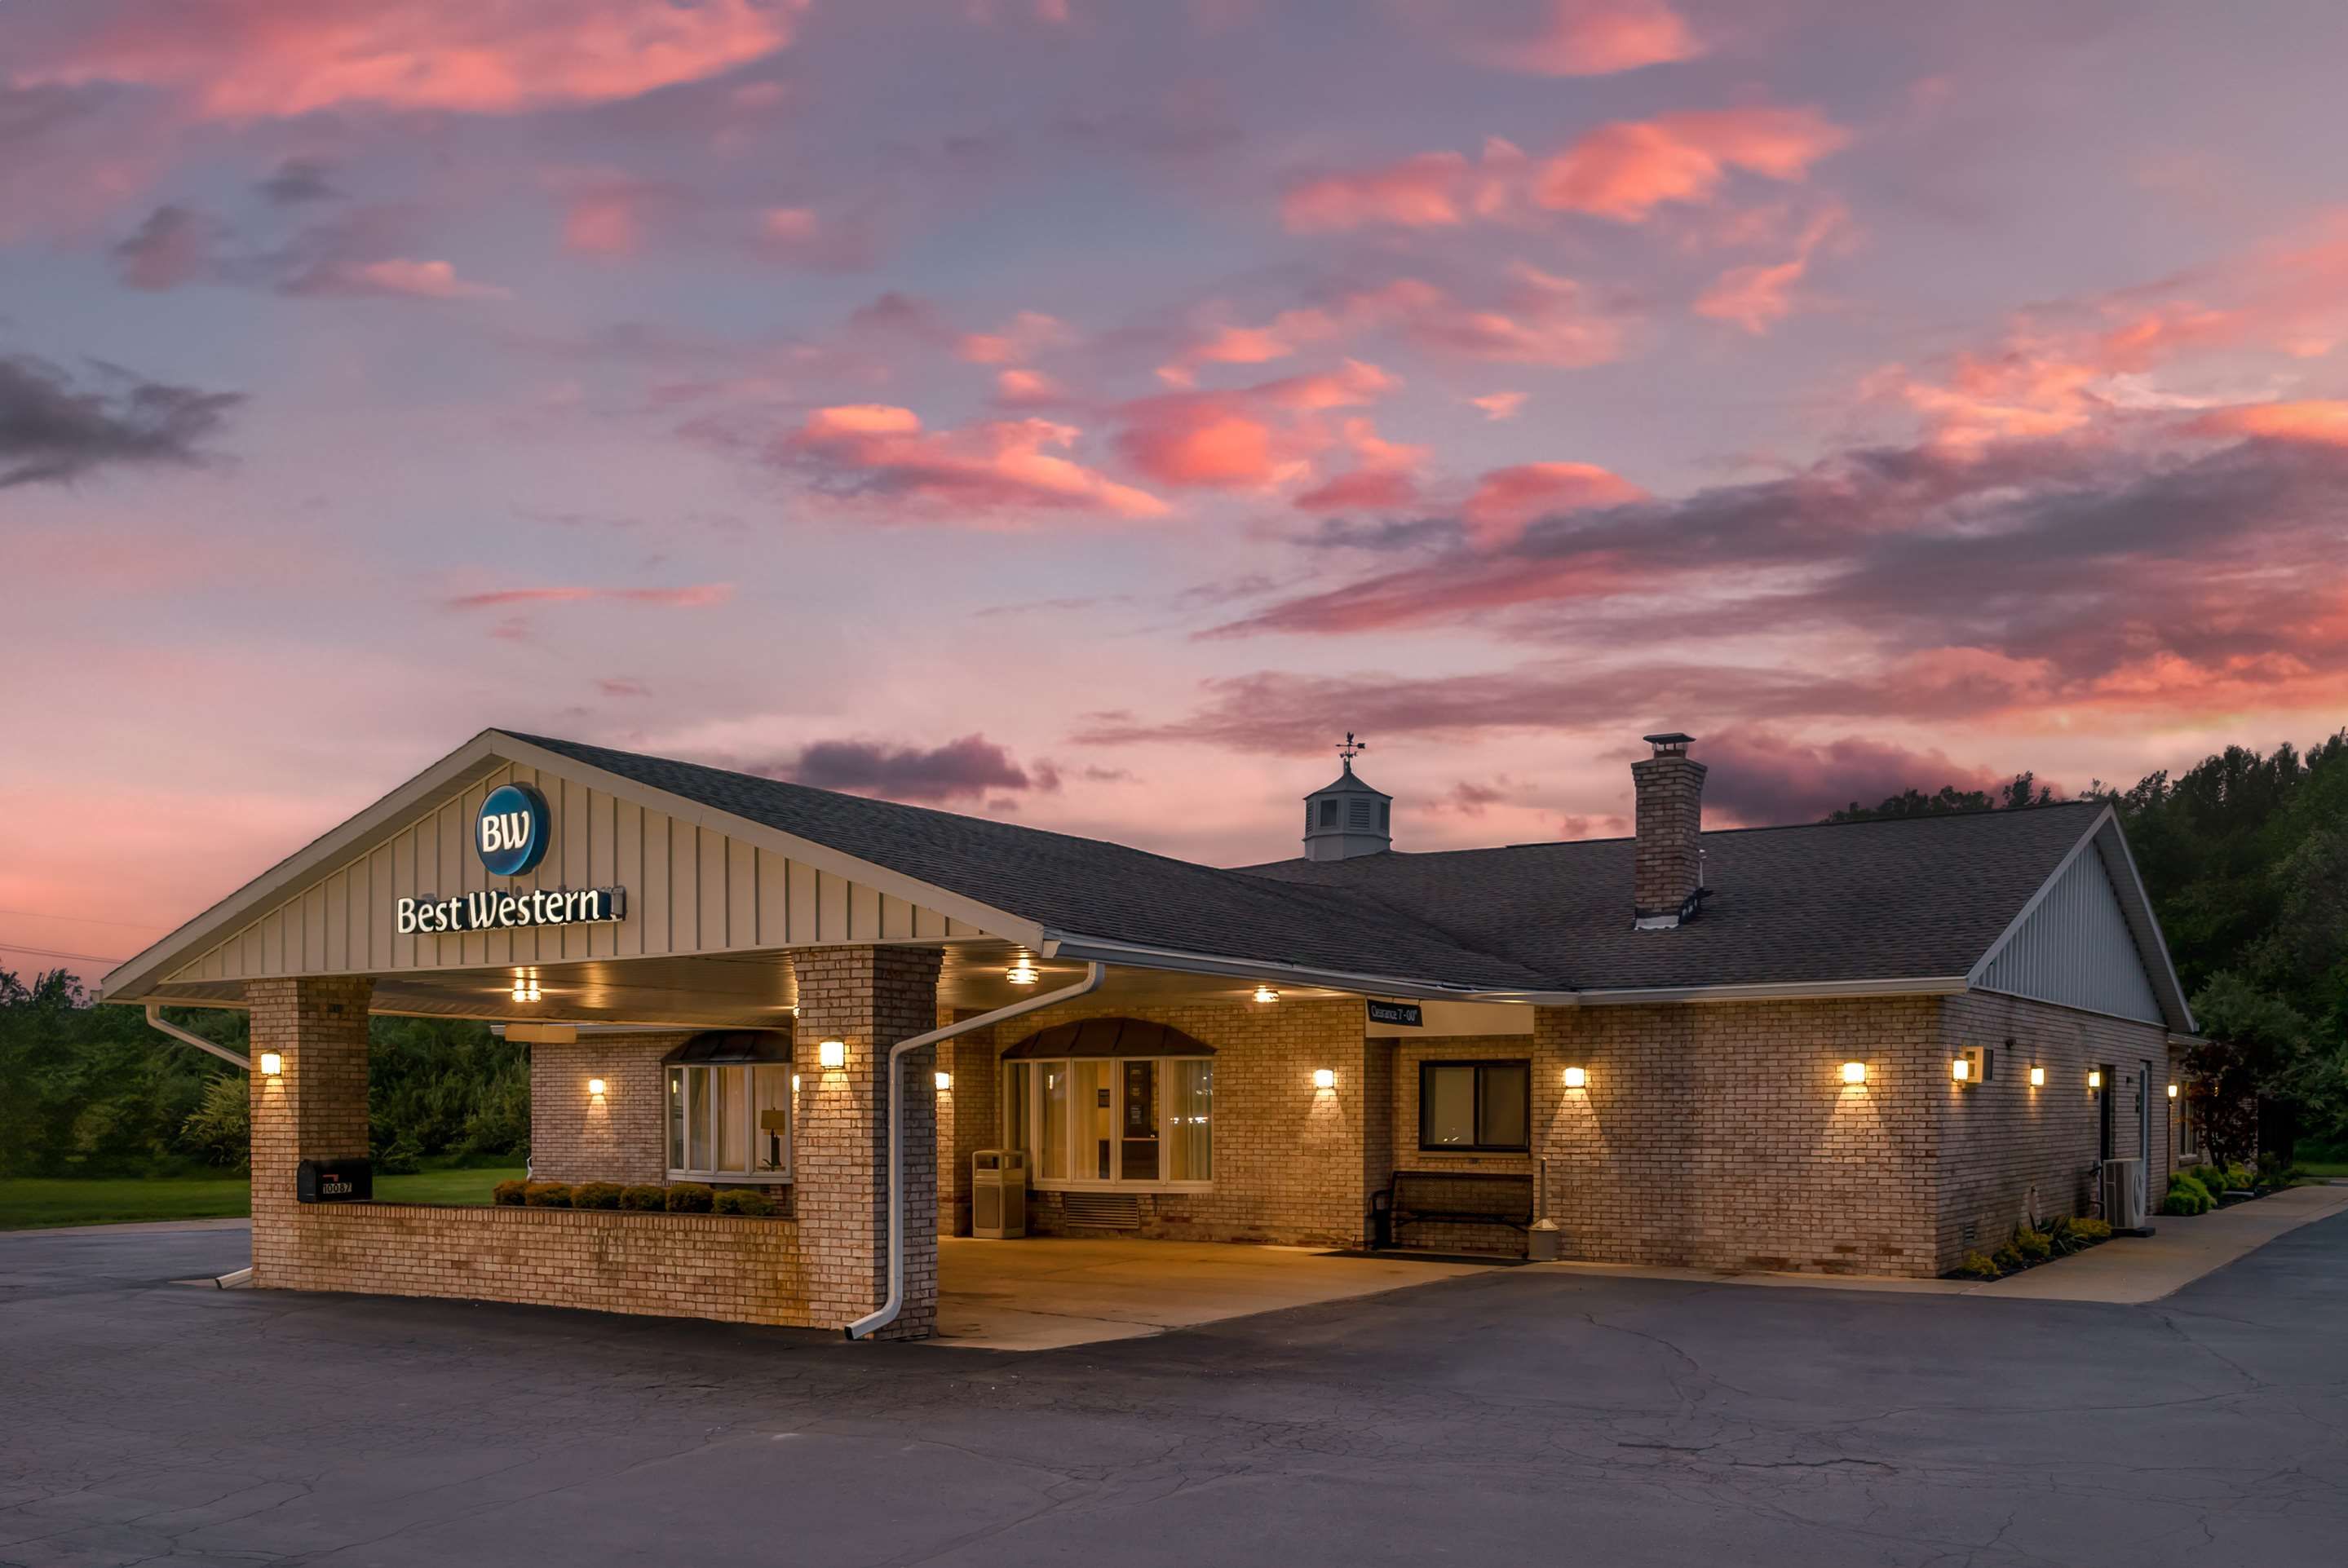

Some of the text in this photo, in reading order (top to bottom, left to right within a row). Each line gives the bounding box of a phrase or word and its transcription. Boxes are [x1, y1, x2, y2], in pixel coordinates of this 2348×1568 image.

[482, 811, 529, 853] BW
[397, 889, 600, 934] Best Western
